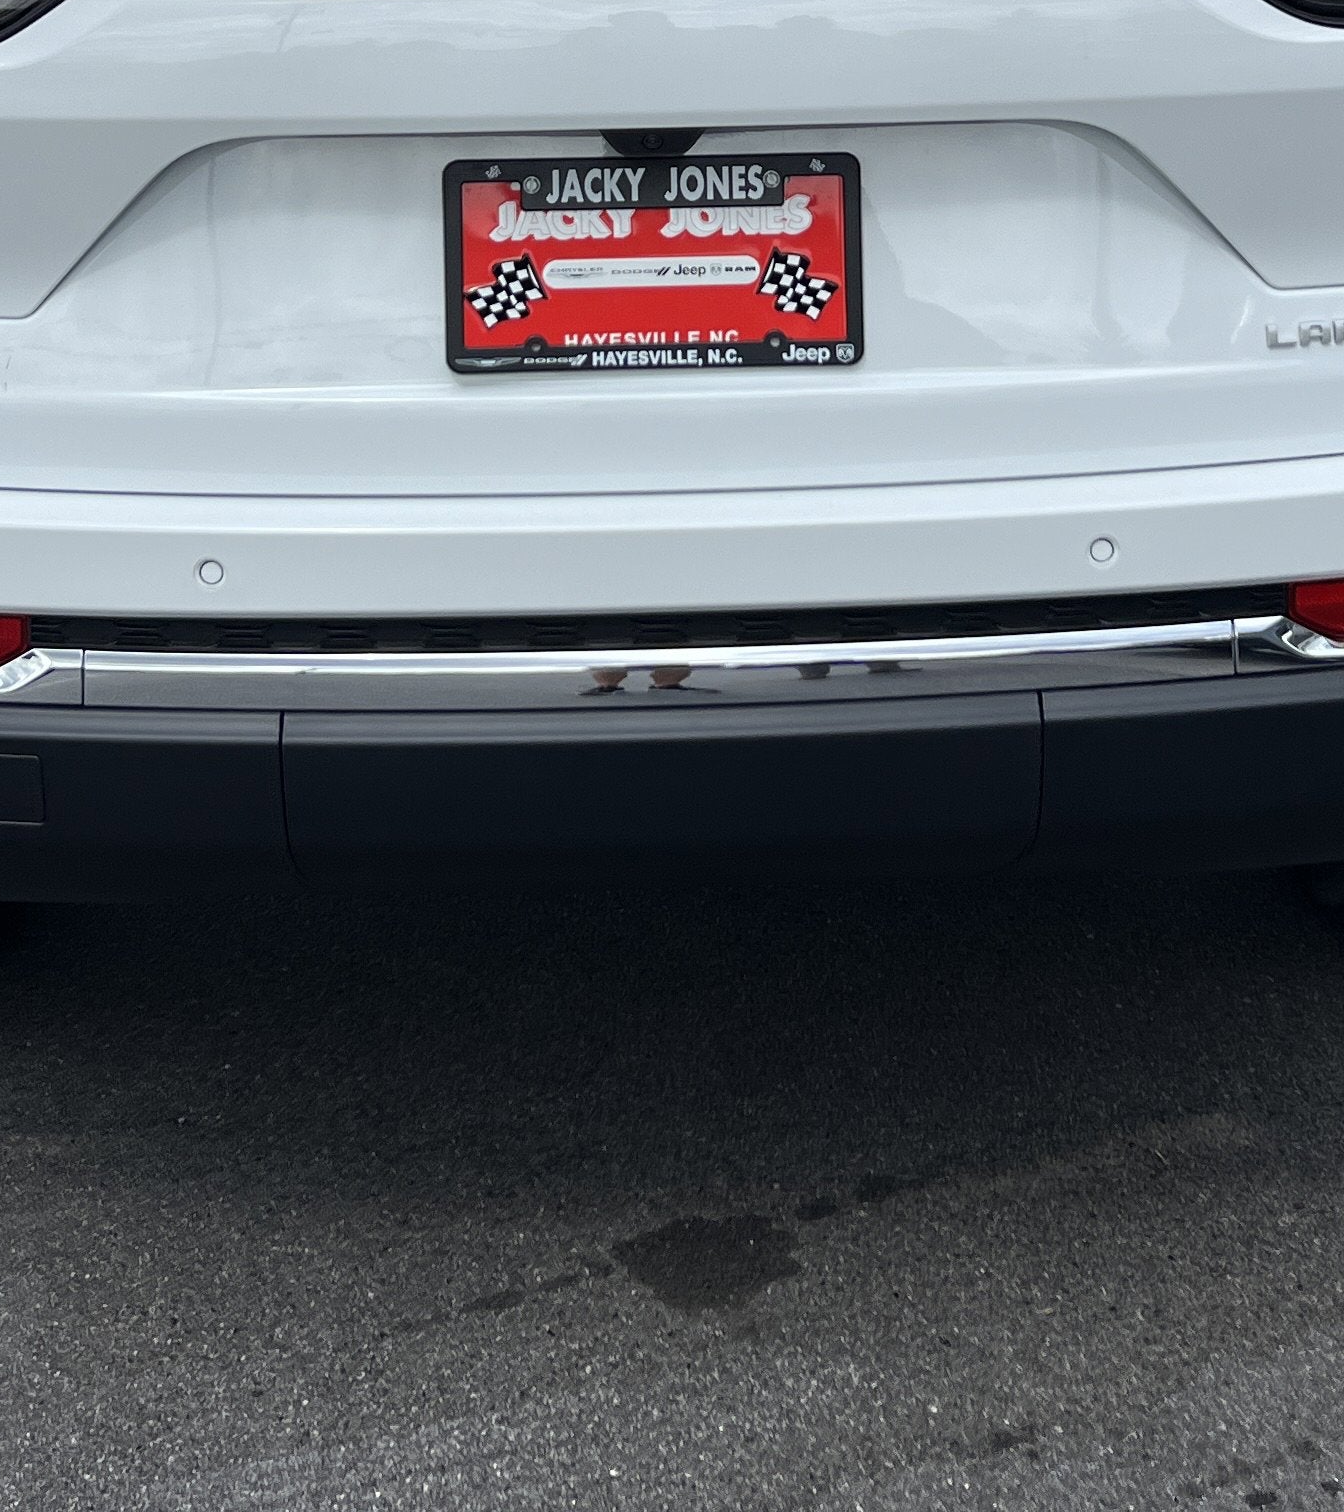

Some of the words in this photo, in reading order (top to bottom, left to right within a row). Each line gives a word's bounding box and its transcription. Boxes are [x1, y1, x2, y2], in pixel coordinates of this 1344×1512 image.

[545, 167, 646, 204] JACKY
[664, 164, 765, 202] JONES
[489, 200, 636, 242] JACKY
[660, 193, 813, 238] JONES
[673, 264, 707, 277] Jeep
[724, 265, 756, 273] RAM
[591, 348, 703, 367] HAYESVILLE,
[707, 348, 743, 365] N.C.
[781, 344, 831, 364] Jeep
